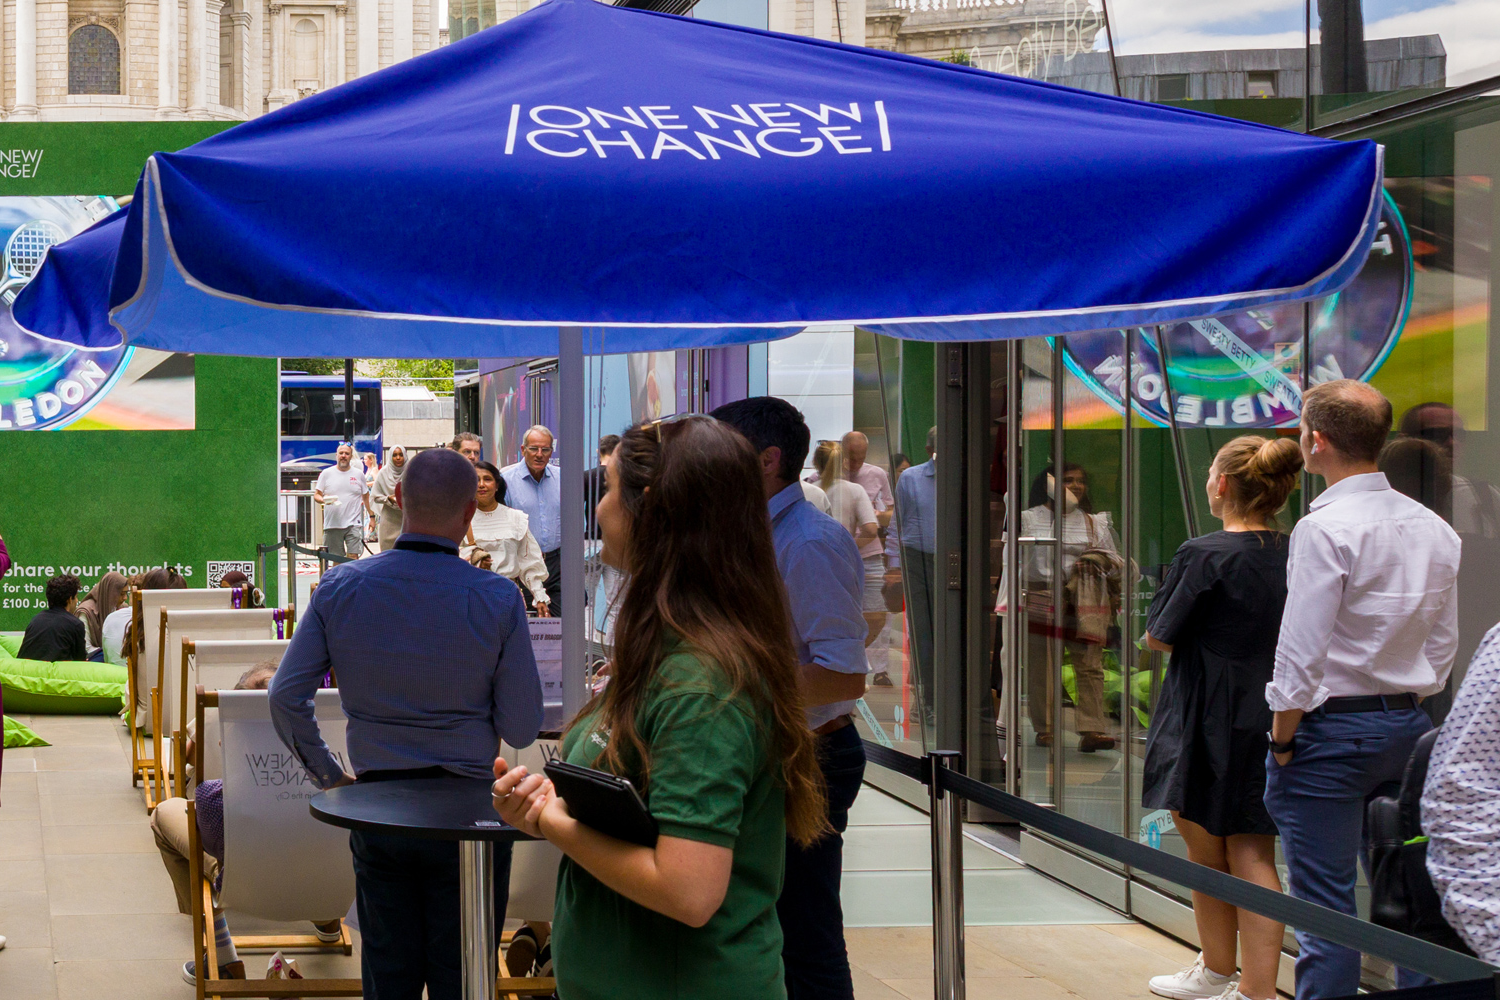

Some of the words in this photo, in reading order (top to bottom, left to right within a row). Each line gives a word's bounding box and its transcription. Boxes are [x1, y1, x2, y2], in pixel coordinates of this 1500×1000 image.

[529, 104, 689, 129] ONE
[692, 102, 862, 128] NEW
[526, 126, 873, 159] CHANGE
[0, 149, 39, 164] NEW
[1201, 319, 1232, 350] SWEATY
[1230, 342, 1257, 370] BETTY
[1264, 370, 1298, 405] SWEATY
[60, 565, 102, 577] your
[106, 561, 193, 577] thouts
[2, 582, 21, 593] for
[23, 582, 44, 593] the
[2, 598, 30, 609] £100
